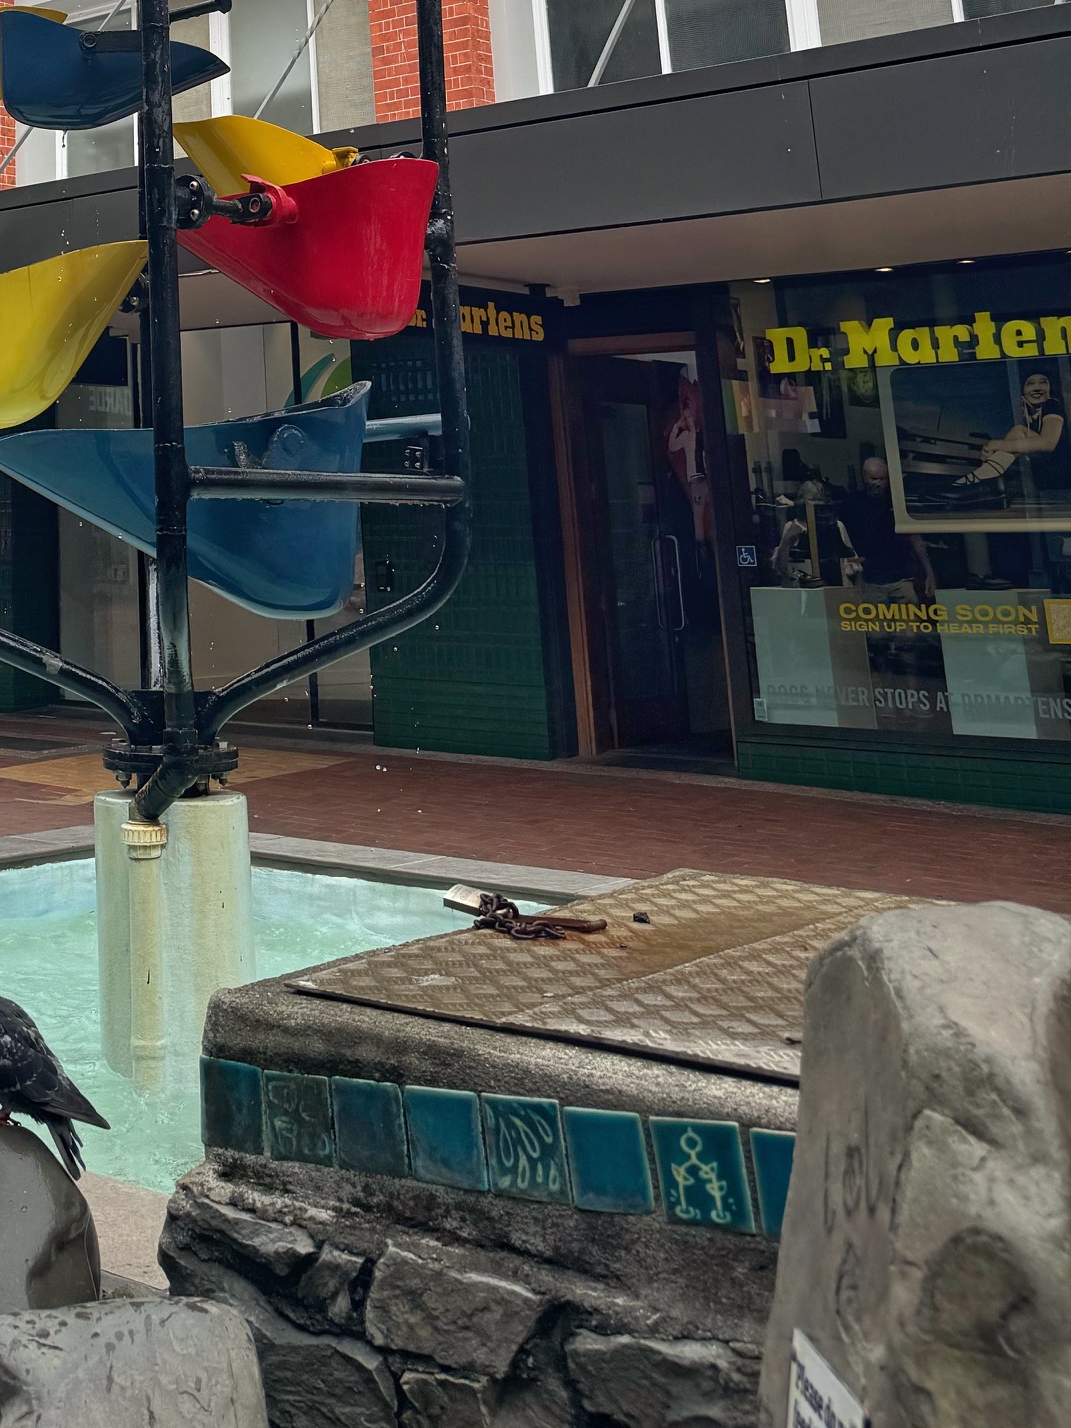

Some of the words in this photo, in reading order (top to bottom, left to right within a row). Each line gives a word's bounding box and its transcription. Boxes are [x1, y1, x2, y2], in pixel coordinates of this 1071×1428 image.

[433, 301, 545, 342] artens
[765, 326, 832, 374] Dr.
[839, 602, 949, 621] COMING
[955, 604, 1039, 622] SOON
[840, 621, 880, 632] SIGN
[884, 622, 906, 633] UP
[910, 622, 933, 633] TO
[937, 623, 984, 635] HEAR
[988, 624, 1039, 636] FIRST
[875, 687, 930, 711] STOPS
